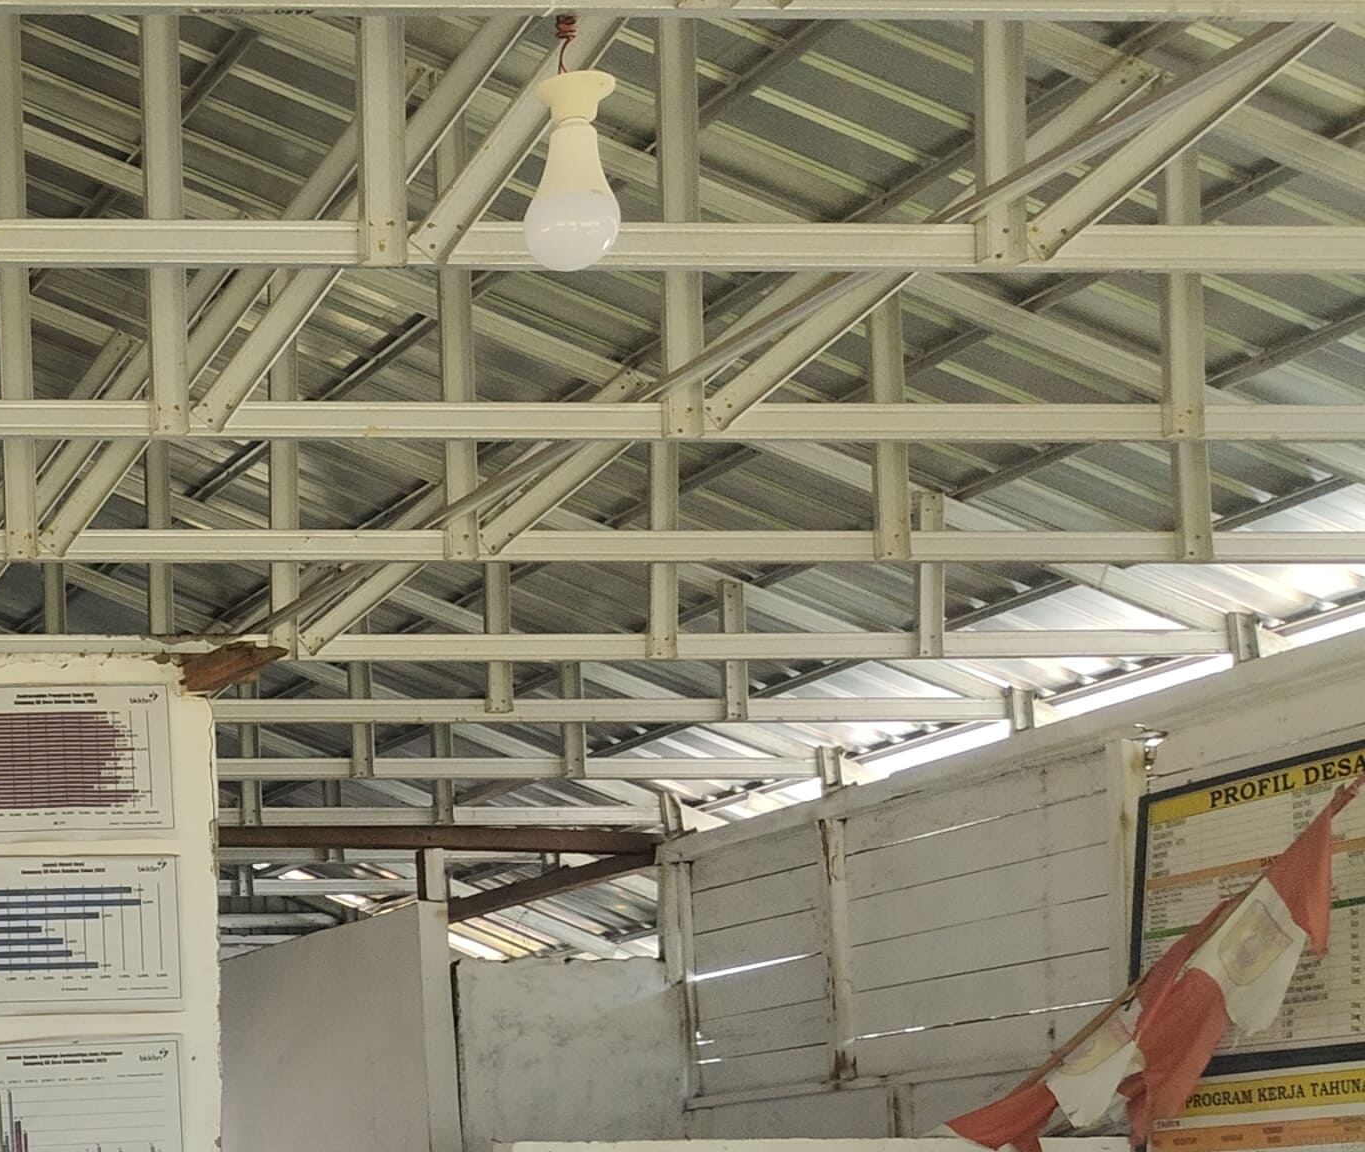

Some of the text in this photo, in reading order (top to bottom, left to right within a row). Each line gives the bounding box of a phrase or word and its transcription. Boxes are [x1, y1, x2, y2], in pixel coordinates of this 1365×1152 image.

[1210, 773, 1295, 808] PROFIL
[1185, 1089, 1253, 1110] PROGRAM
[1257, 1084, 1306, 1104] KERJA
